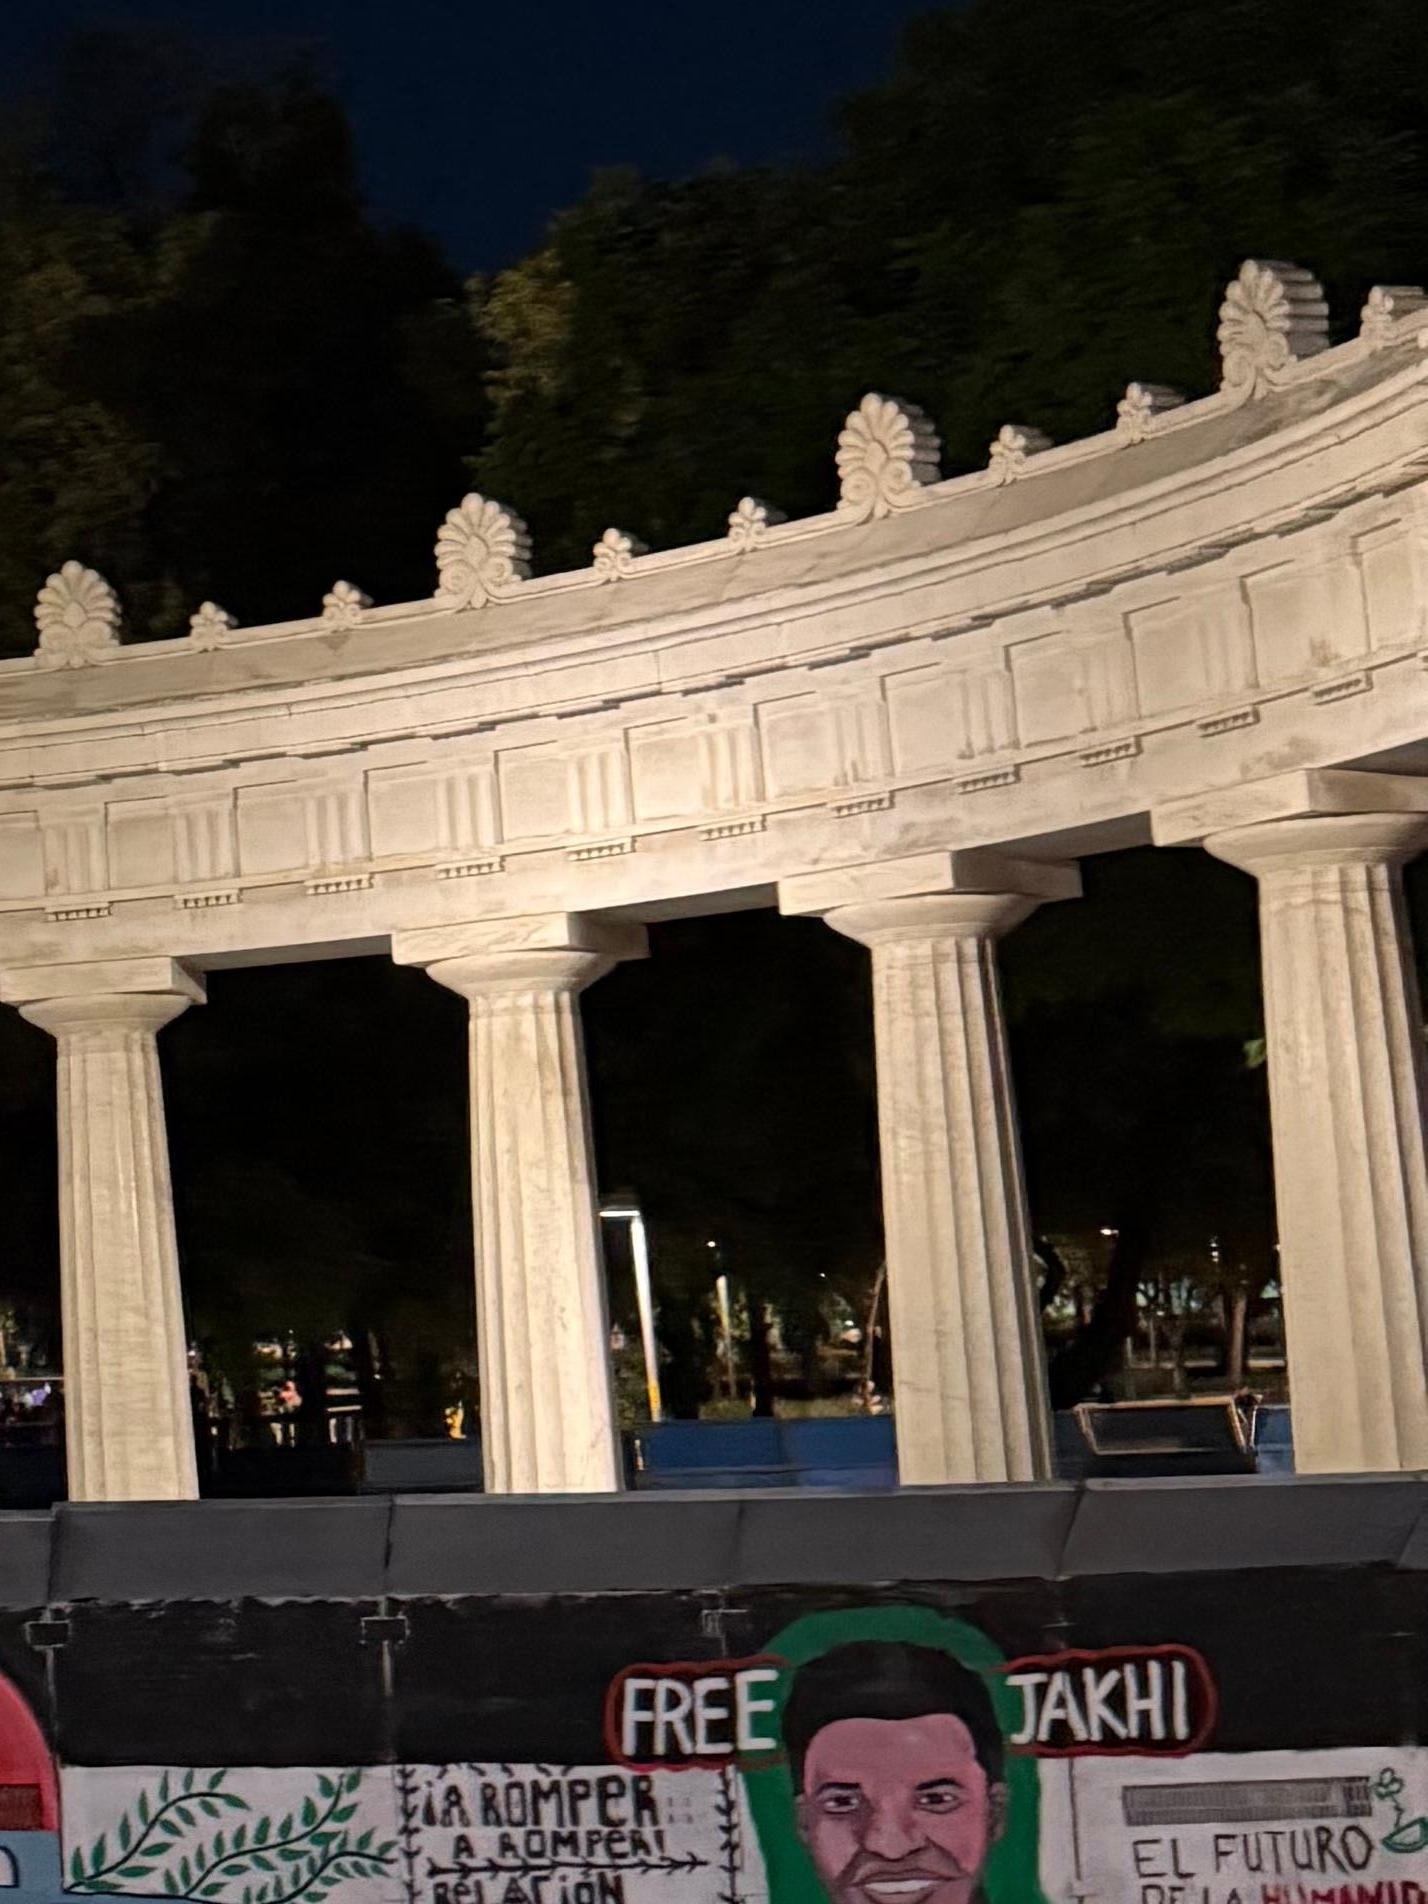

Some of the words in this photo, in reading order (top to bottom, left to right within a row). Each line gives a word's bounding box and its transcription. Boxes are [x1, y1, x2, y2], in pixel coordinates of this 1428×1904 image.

[622, 1668, 778, 1757] FREE
[1006, 1660, 1190, 1744] JAKHI
[452, 1834, 474, 1859] A
[1132, 1838, 1196, 1879] EL
[1213, 1825, 1374, 1874] FUTURO
